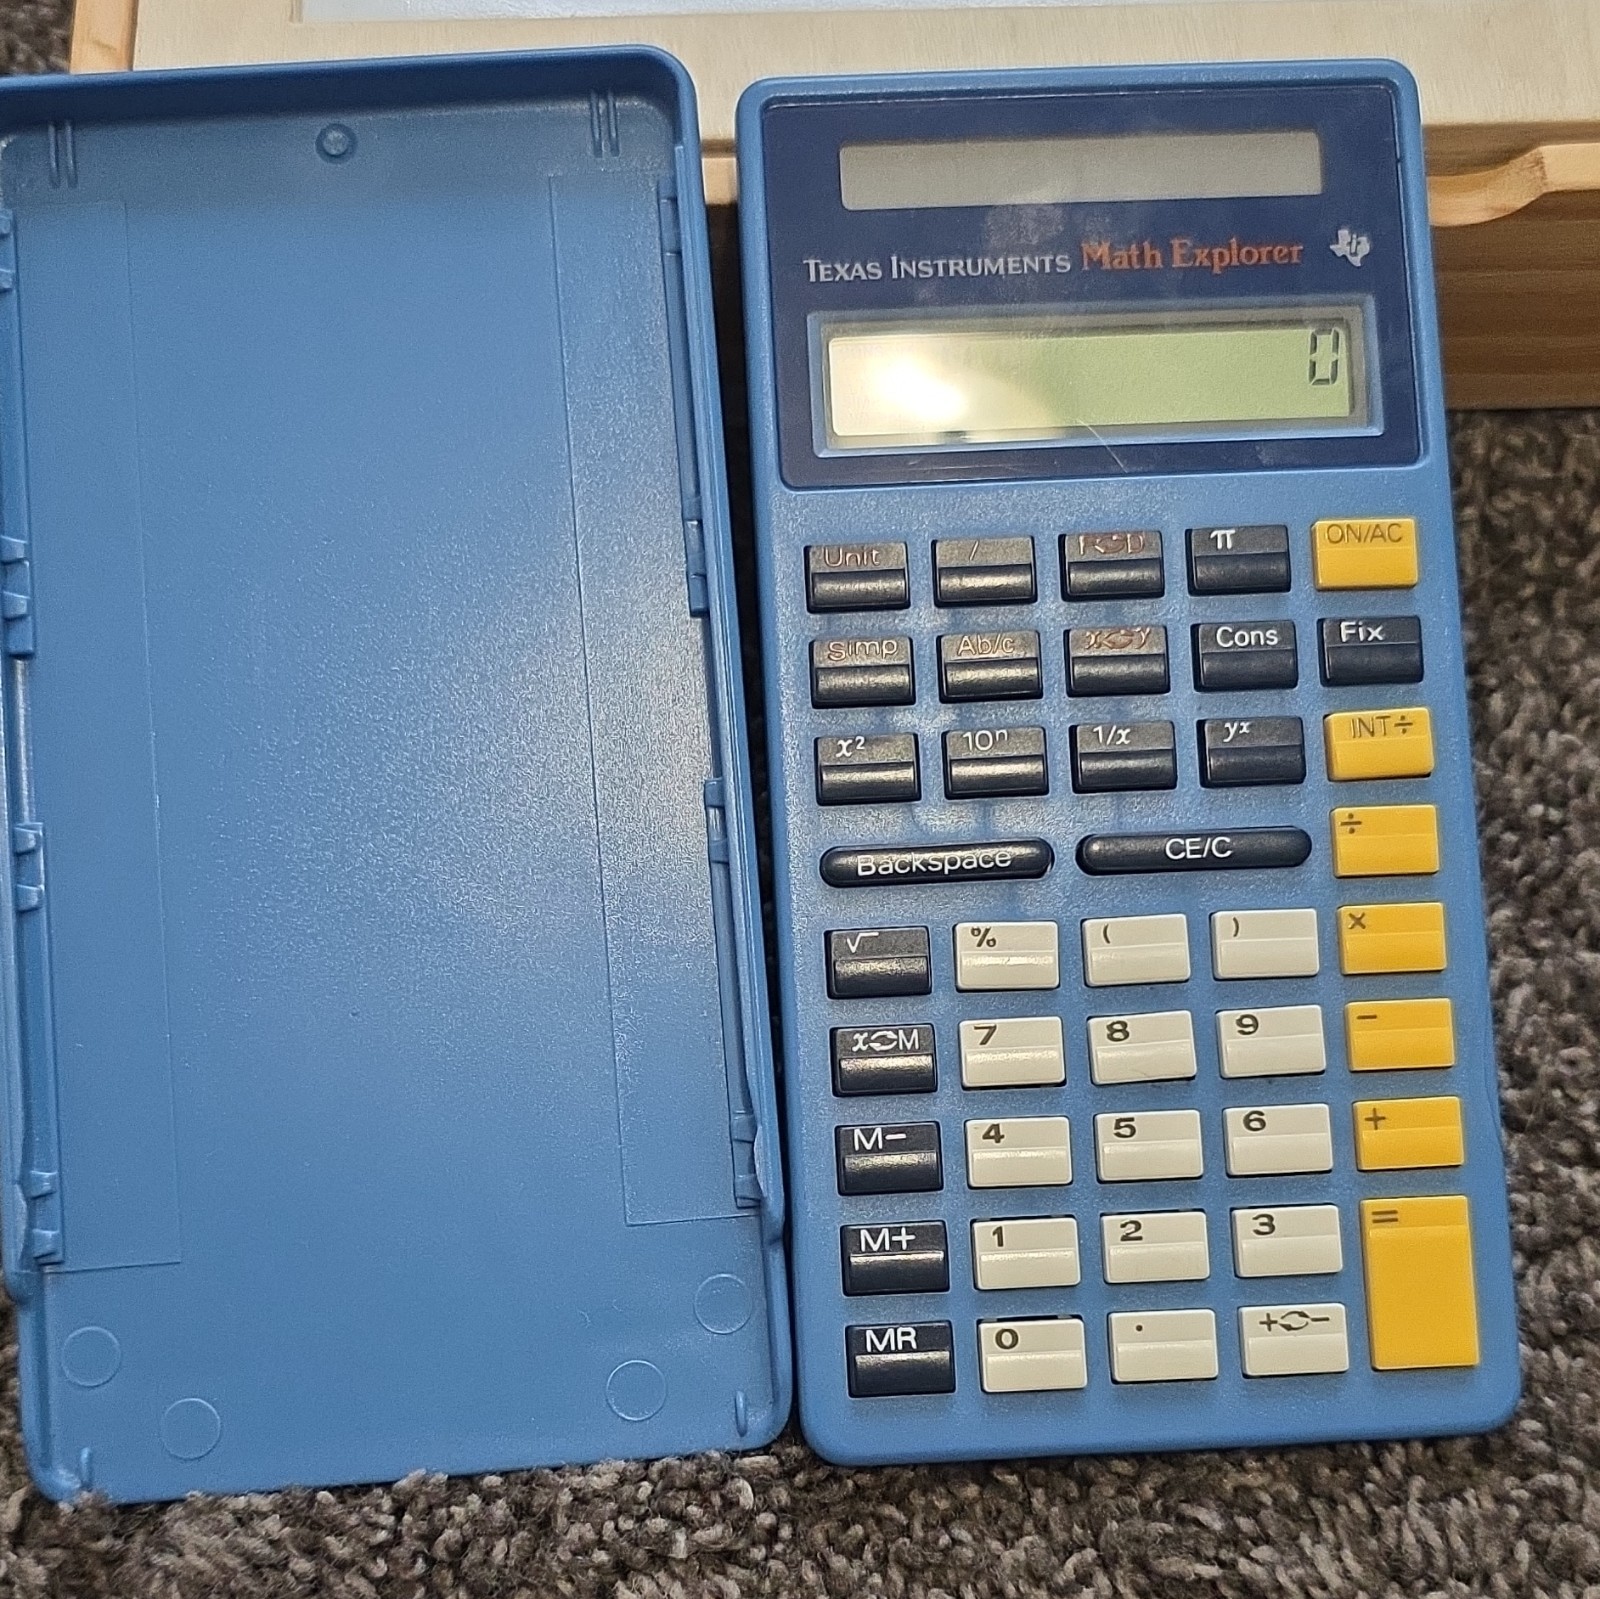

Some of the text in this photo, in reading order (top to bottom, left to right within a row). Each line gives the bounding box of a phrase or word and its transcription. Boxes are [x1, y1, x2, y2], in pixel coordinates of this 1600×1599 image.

[803, 237, 1304, 282] TEXAS INSTRUMENTS Math Explorer
[1308, 326, 1341, 387] 0
[1326, 523, 1403, 545] ON/AC
[823, 547, 880, 568] Unit
[1215, 626, 1279, 648] Cons
[1339, 621, 1386, 643] Fix
[827, 638, 898, 662] Simp
[957, 634, 1016, 657] Ab/c
[1164, 836, 1233, 860] CE/C
[856, 850, 1012, 877] Backspace
[973, 1023, 998, 1046] 7
[1105, 1019, 1131, 1042] 8
[1235, 1013, 1260, 1035] 9
[1113, 1117, 1137, 1138] 5
[1242, 1109, 1267, 1132] 6
[981, 1123, 1005, 1144] 4
[1119, 1220, 1144, 1242] 2
[1252, 1213, 1276, 1236] 3
[859, 1226, 917, 1252] M+
[991, 1225, 1005, 1248] 1
[865, 1326, 918, 1353] MR
[994, 1328, 1019, 1350] 0
